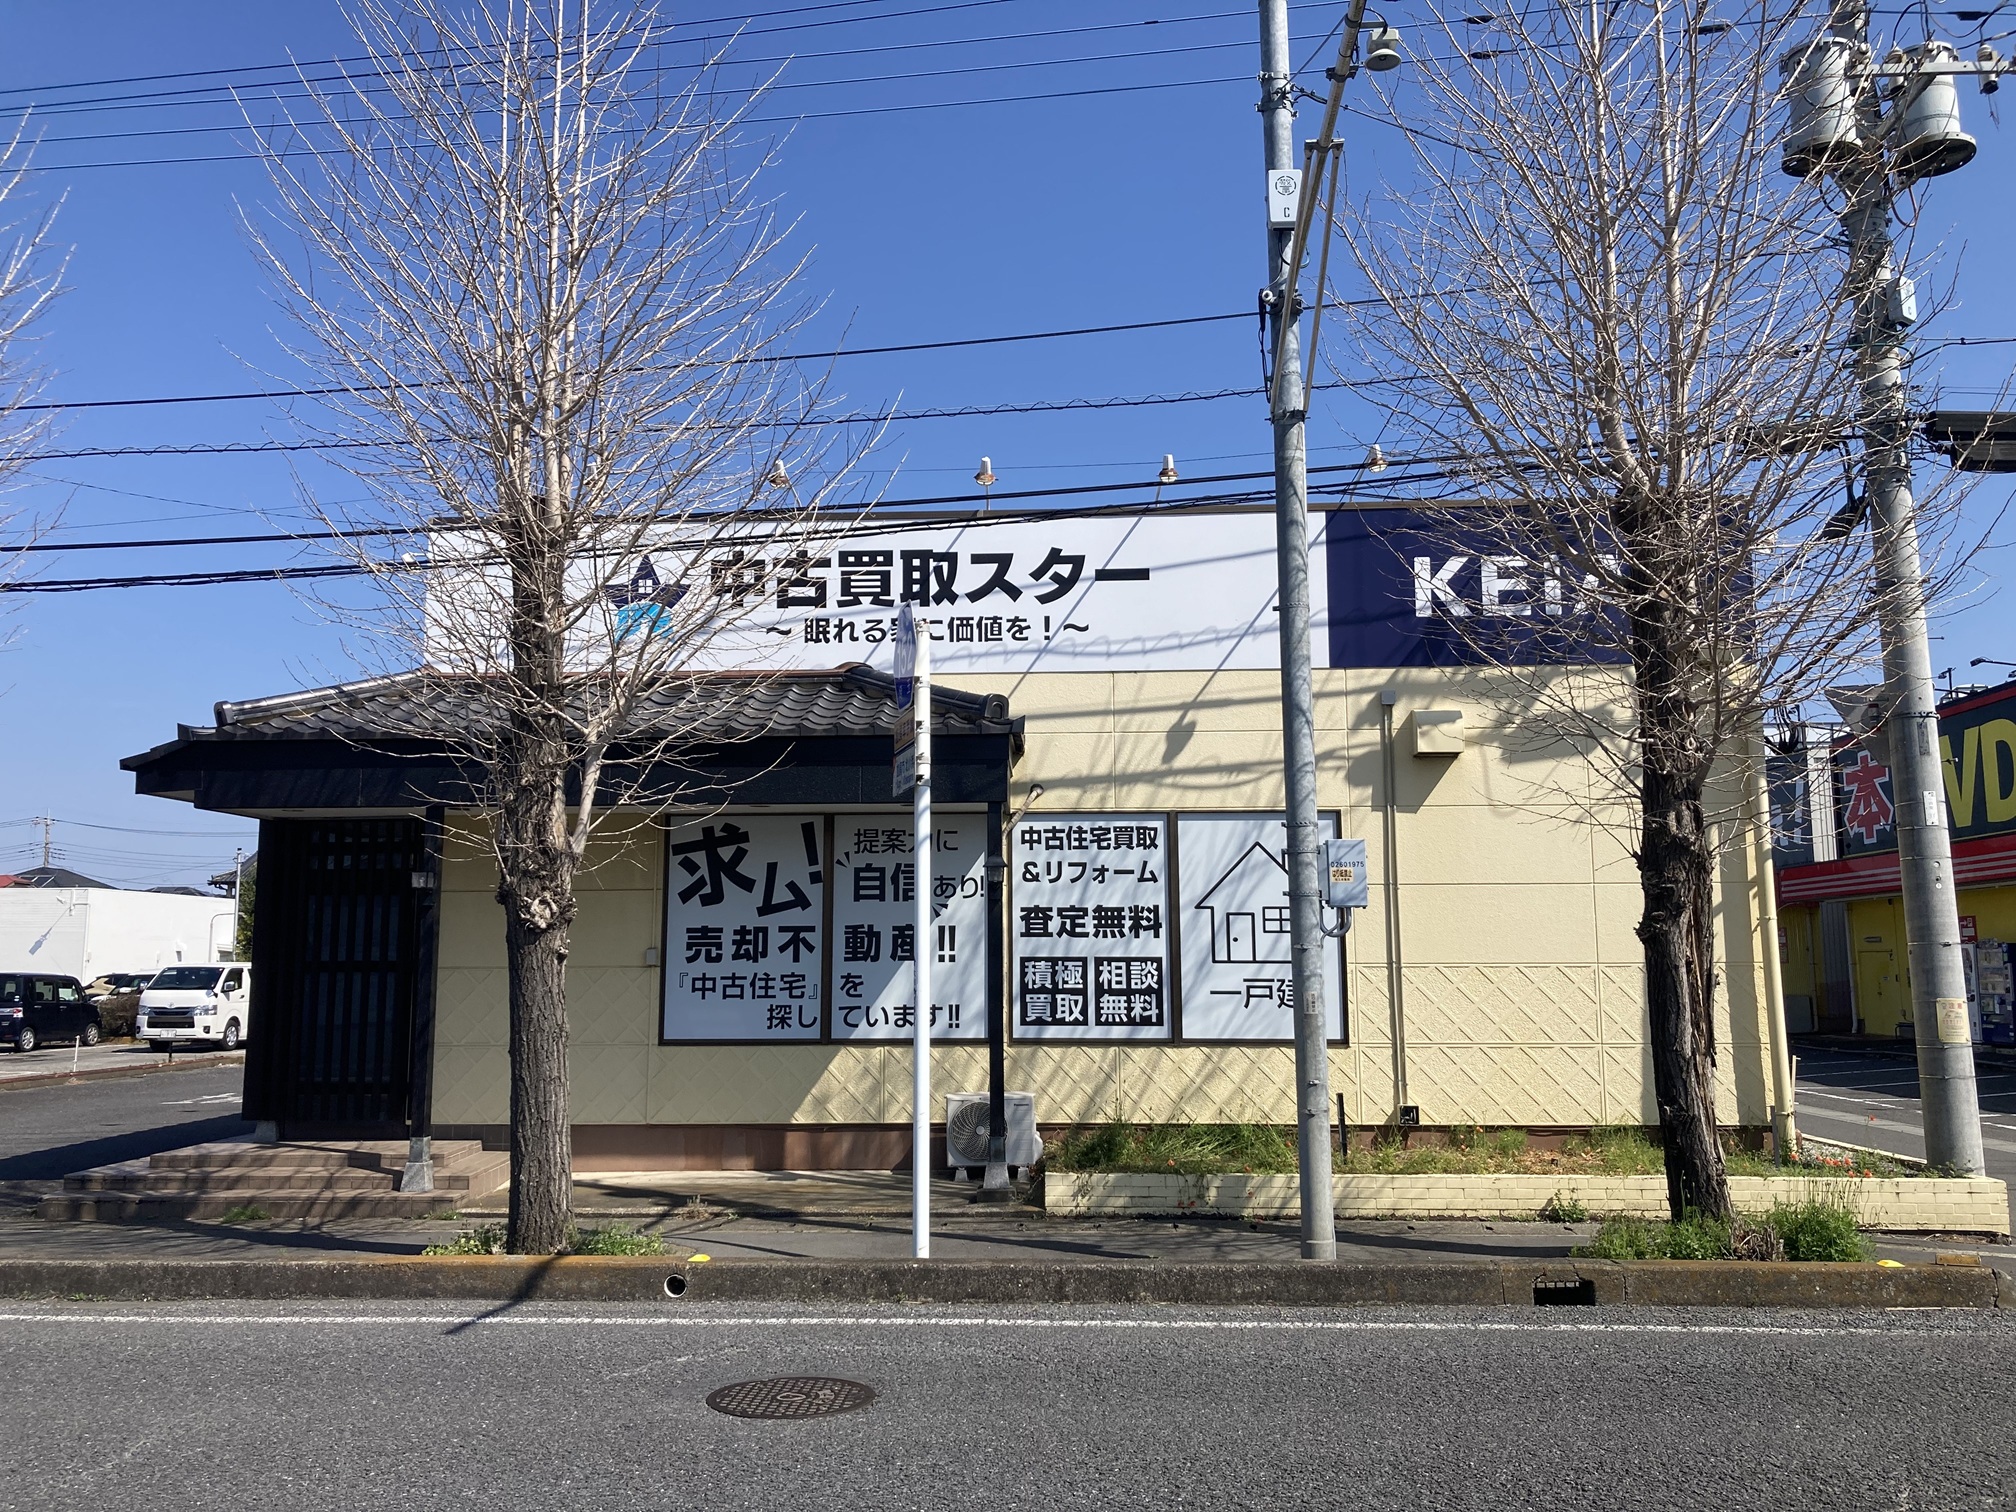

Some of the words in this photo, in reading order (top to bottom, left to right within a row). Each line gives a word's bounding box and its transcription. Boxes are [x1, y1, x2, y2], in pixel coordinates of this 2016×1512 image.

[1284, 207, 1290, 218] C
[711, 547, 1150, 608] 中古買取スター
[897, 631, 912, 679] 152
[1844, 750, 1894, 844] 本
[854, 828, 958, 854] 提案に
[1020, 825, 1158, 851] 中古住宅買取
[1022, 861, 1158, 884] &リフォーム
[1020, 904, 1162, 939] 査定無料
[1024, 961, 1083, 990] 積極
[1099, 961, 1159, 990] 相談
[1024, 994, 1083, 1023] 買取
[1099, 993, 1159, 1023] 無料
